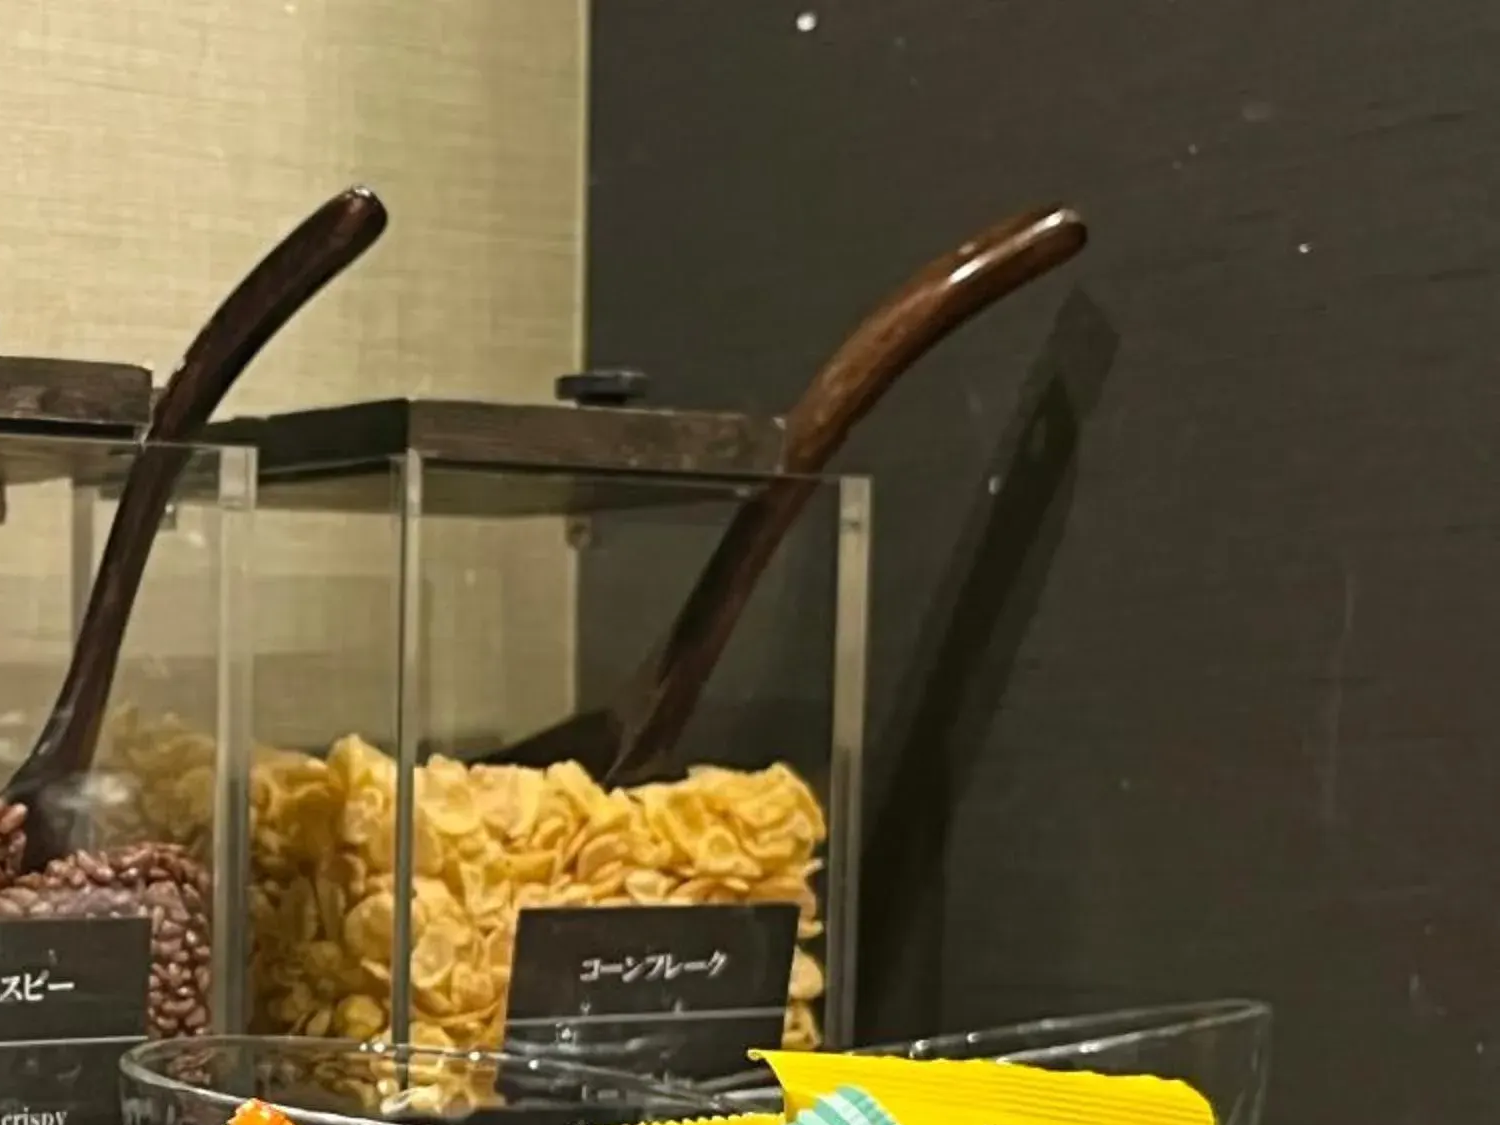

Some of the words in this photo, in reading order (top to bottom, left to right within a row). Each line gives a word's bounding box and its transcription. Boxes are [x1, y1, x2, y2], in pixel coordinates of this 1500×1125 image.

[579, 950, 728, 984] コーンフレーク
